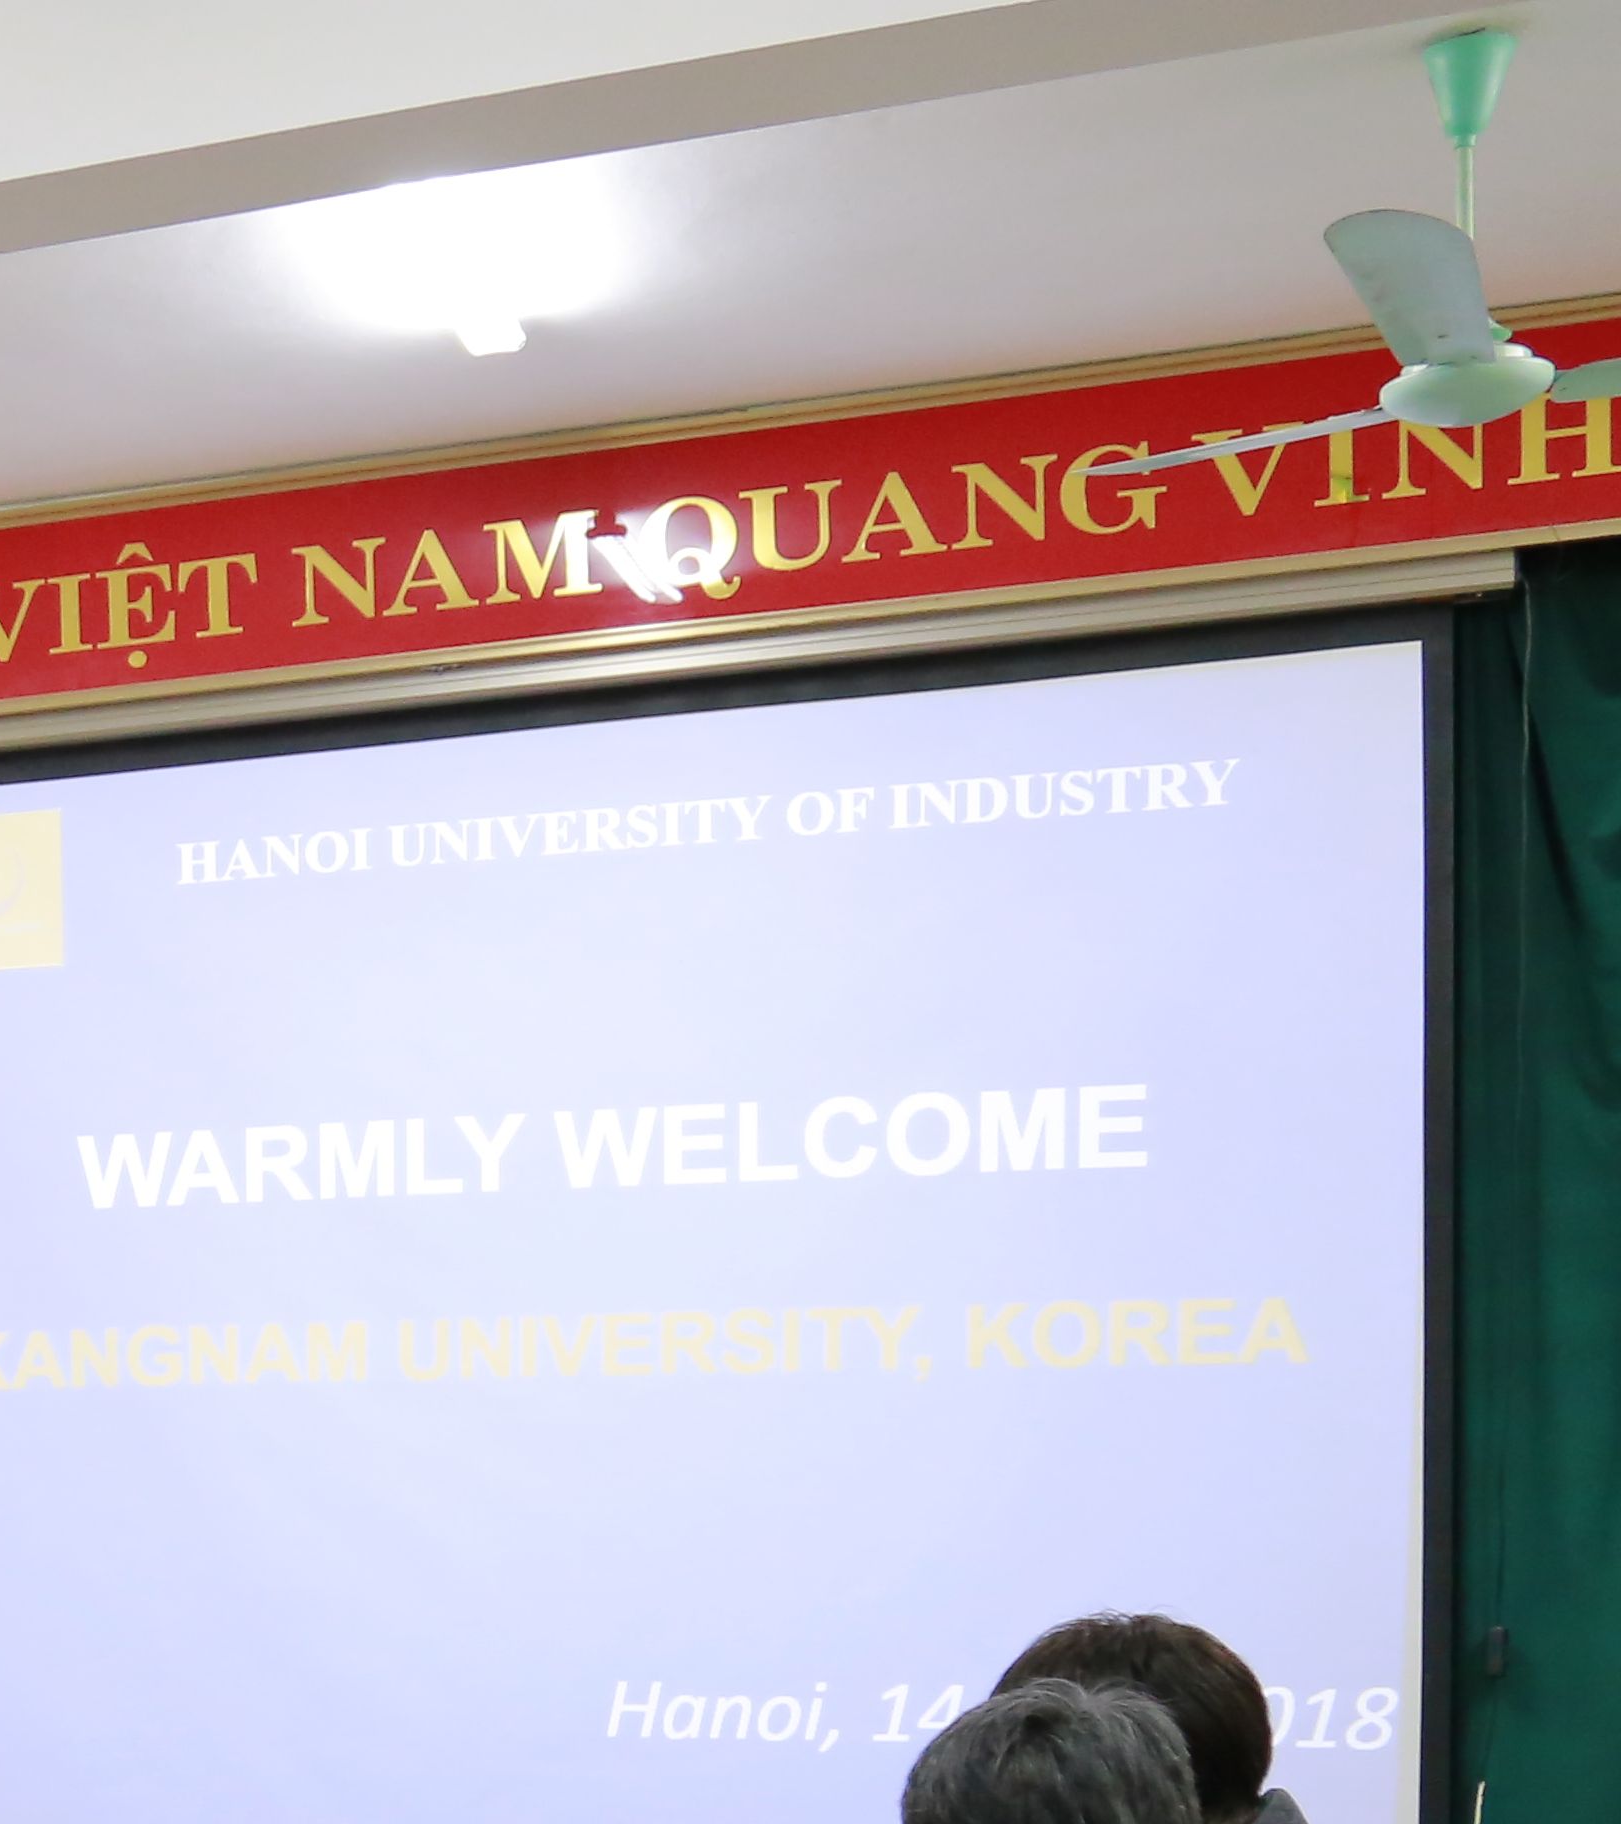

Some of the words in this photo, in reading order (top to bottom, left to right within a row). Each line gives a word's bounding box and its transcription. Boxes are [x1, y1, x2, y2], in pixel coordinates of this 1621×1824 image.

[291, 508, 603, 627] NAM
[637, 442, 1167, 601] QUANG
[1191, 392, 1621, 517] VINH
[175, 824, 376, 887] HANOI
[385, 795, 769, 868] UNIVERSITY
[781, 786, 878, 839] OF
[887, 758, 1240, 832] INDUSTRY
[75, 1112, 527, 1210] WARMLY
[555, 1084, 1149, 1190] WELCOME
[398, 1305, 932, 1383] UNIVERSITY,
[967, 1297, 1310, 1370] KOREA
[607, 1680, 840, 1753] Hanoi,
